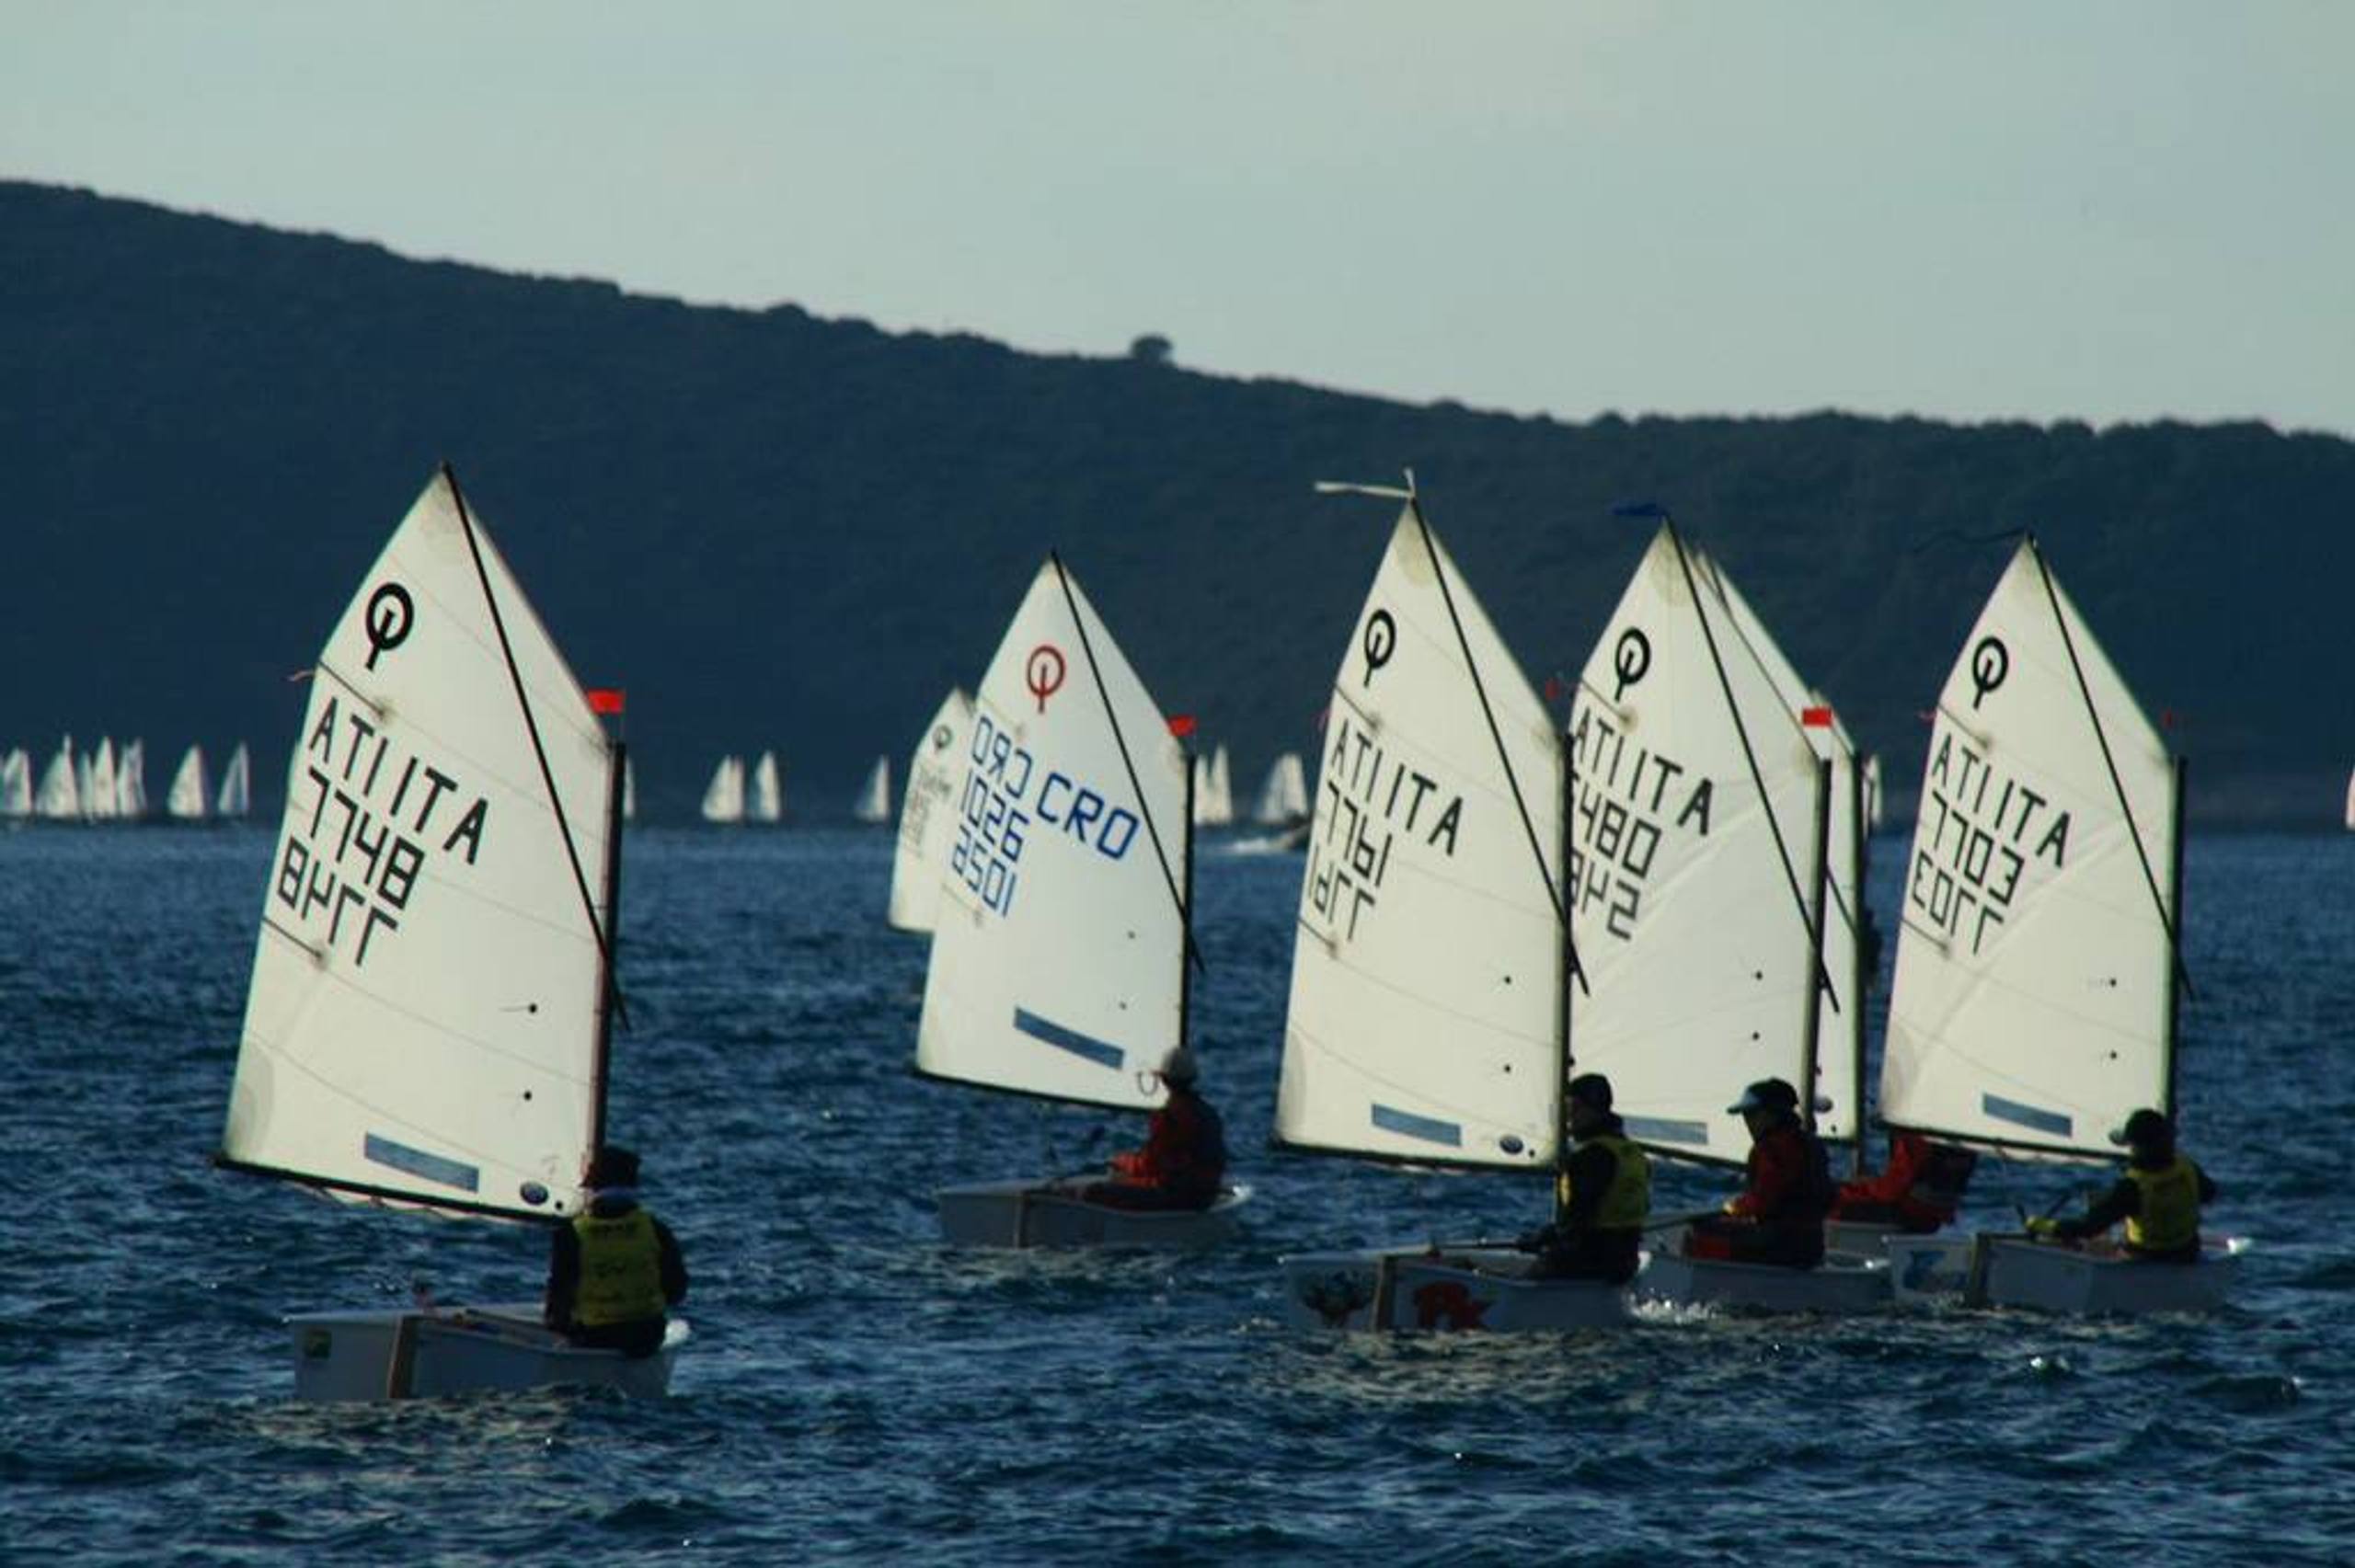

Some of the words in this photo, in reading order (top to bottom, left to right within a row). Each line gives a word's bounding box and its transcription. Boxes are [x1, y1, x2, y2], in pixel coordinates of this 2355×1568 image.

[309, 765, 425, 910] 7748
[390, 756, 488, 865] ITA
[960, 769, 1030, 863] 1026
[1036, 772, 1140, 860] CRO
[1327, 779, 1393, 887] 7761
[1384, 763, 1463, 856] ITA
[1571, 771, 1661, 878] 480
[1629, 749, 1712, 836] ITA
[1994, 780, 2069, 868] ITA
[1933, 789, 2025, 907] 7703
